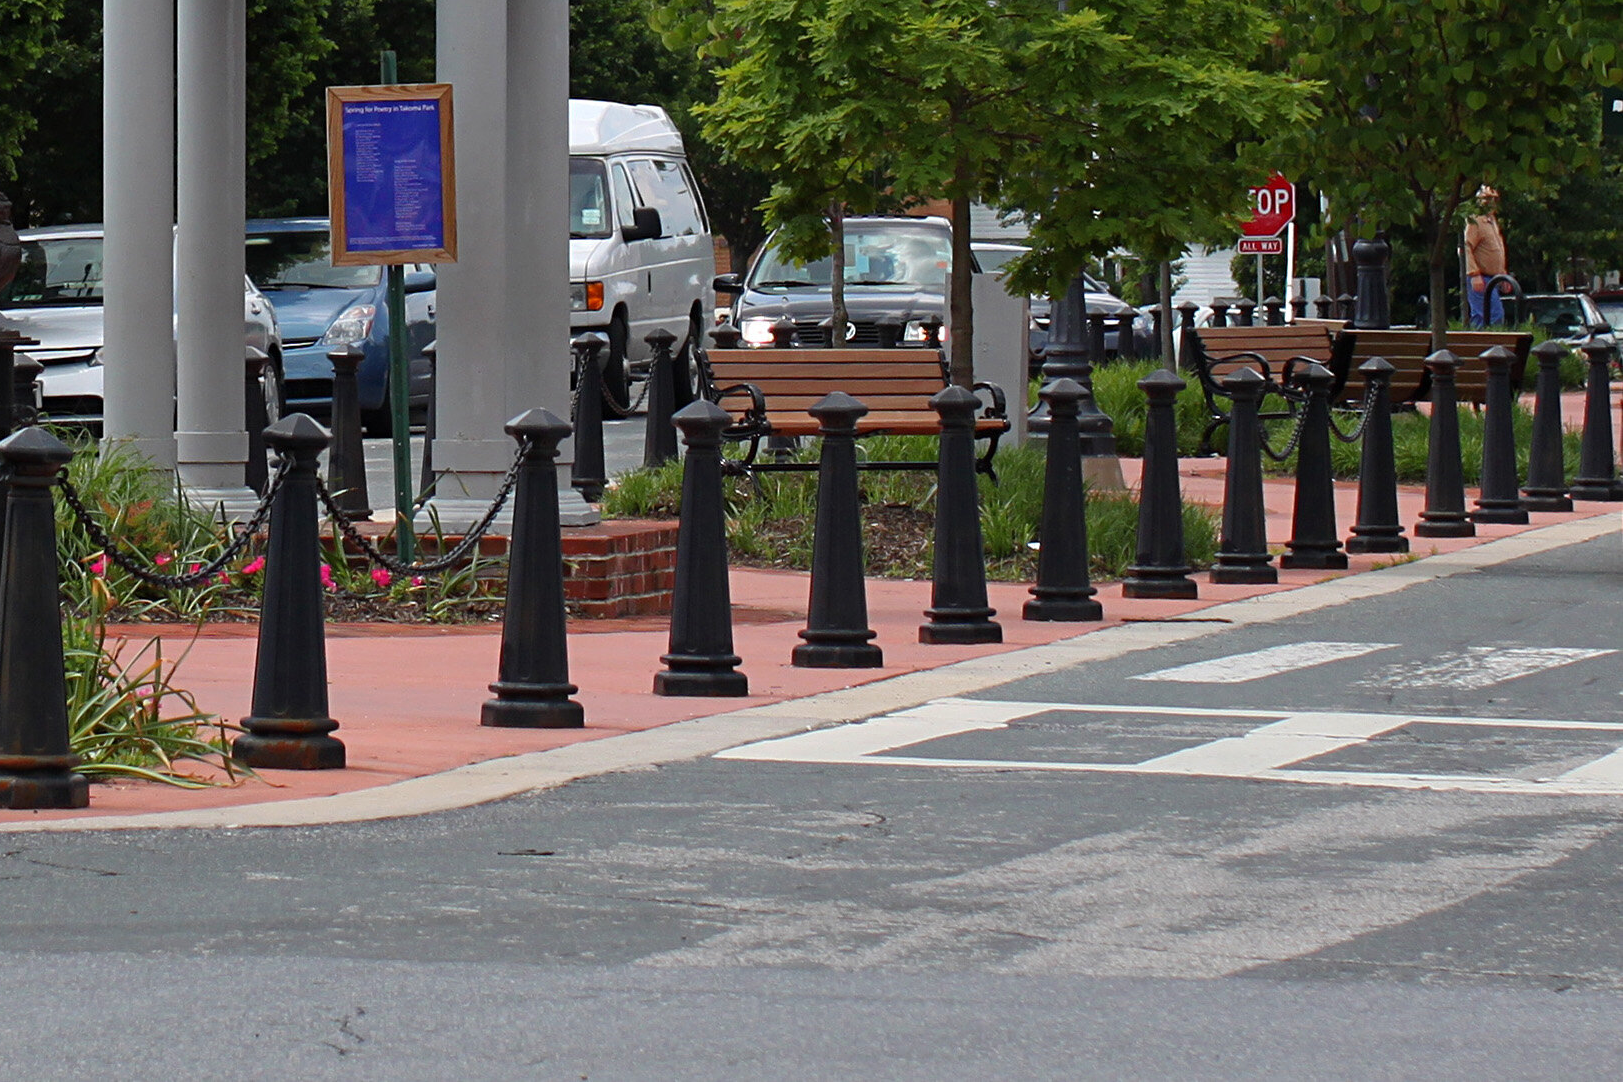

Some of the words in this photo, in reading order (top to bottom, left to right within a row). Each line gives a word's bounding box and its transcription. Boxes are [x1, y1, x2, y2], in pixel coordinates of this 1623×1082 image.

[1247, 188, 1290, 215] OP
[1242, 241, 1257, 251] ALL
[1261, 241, 1279, 251] WAY
